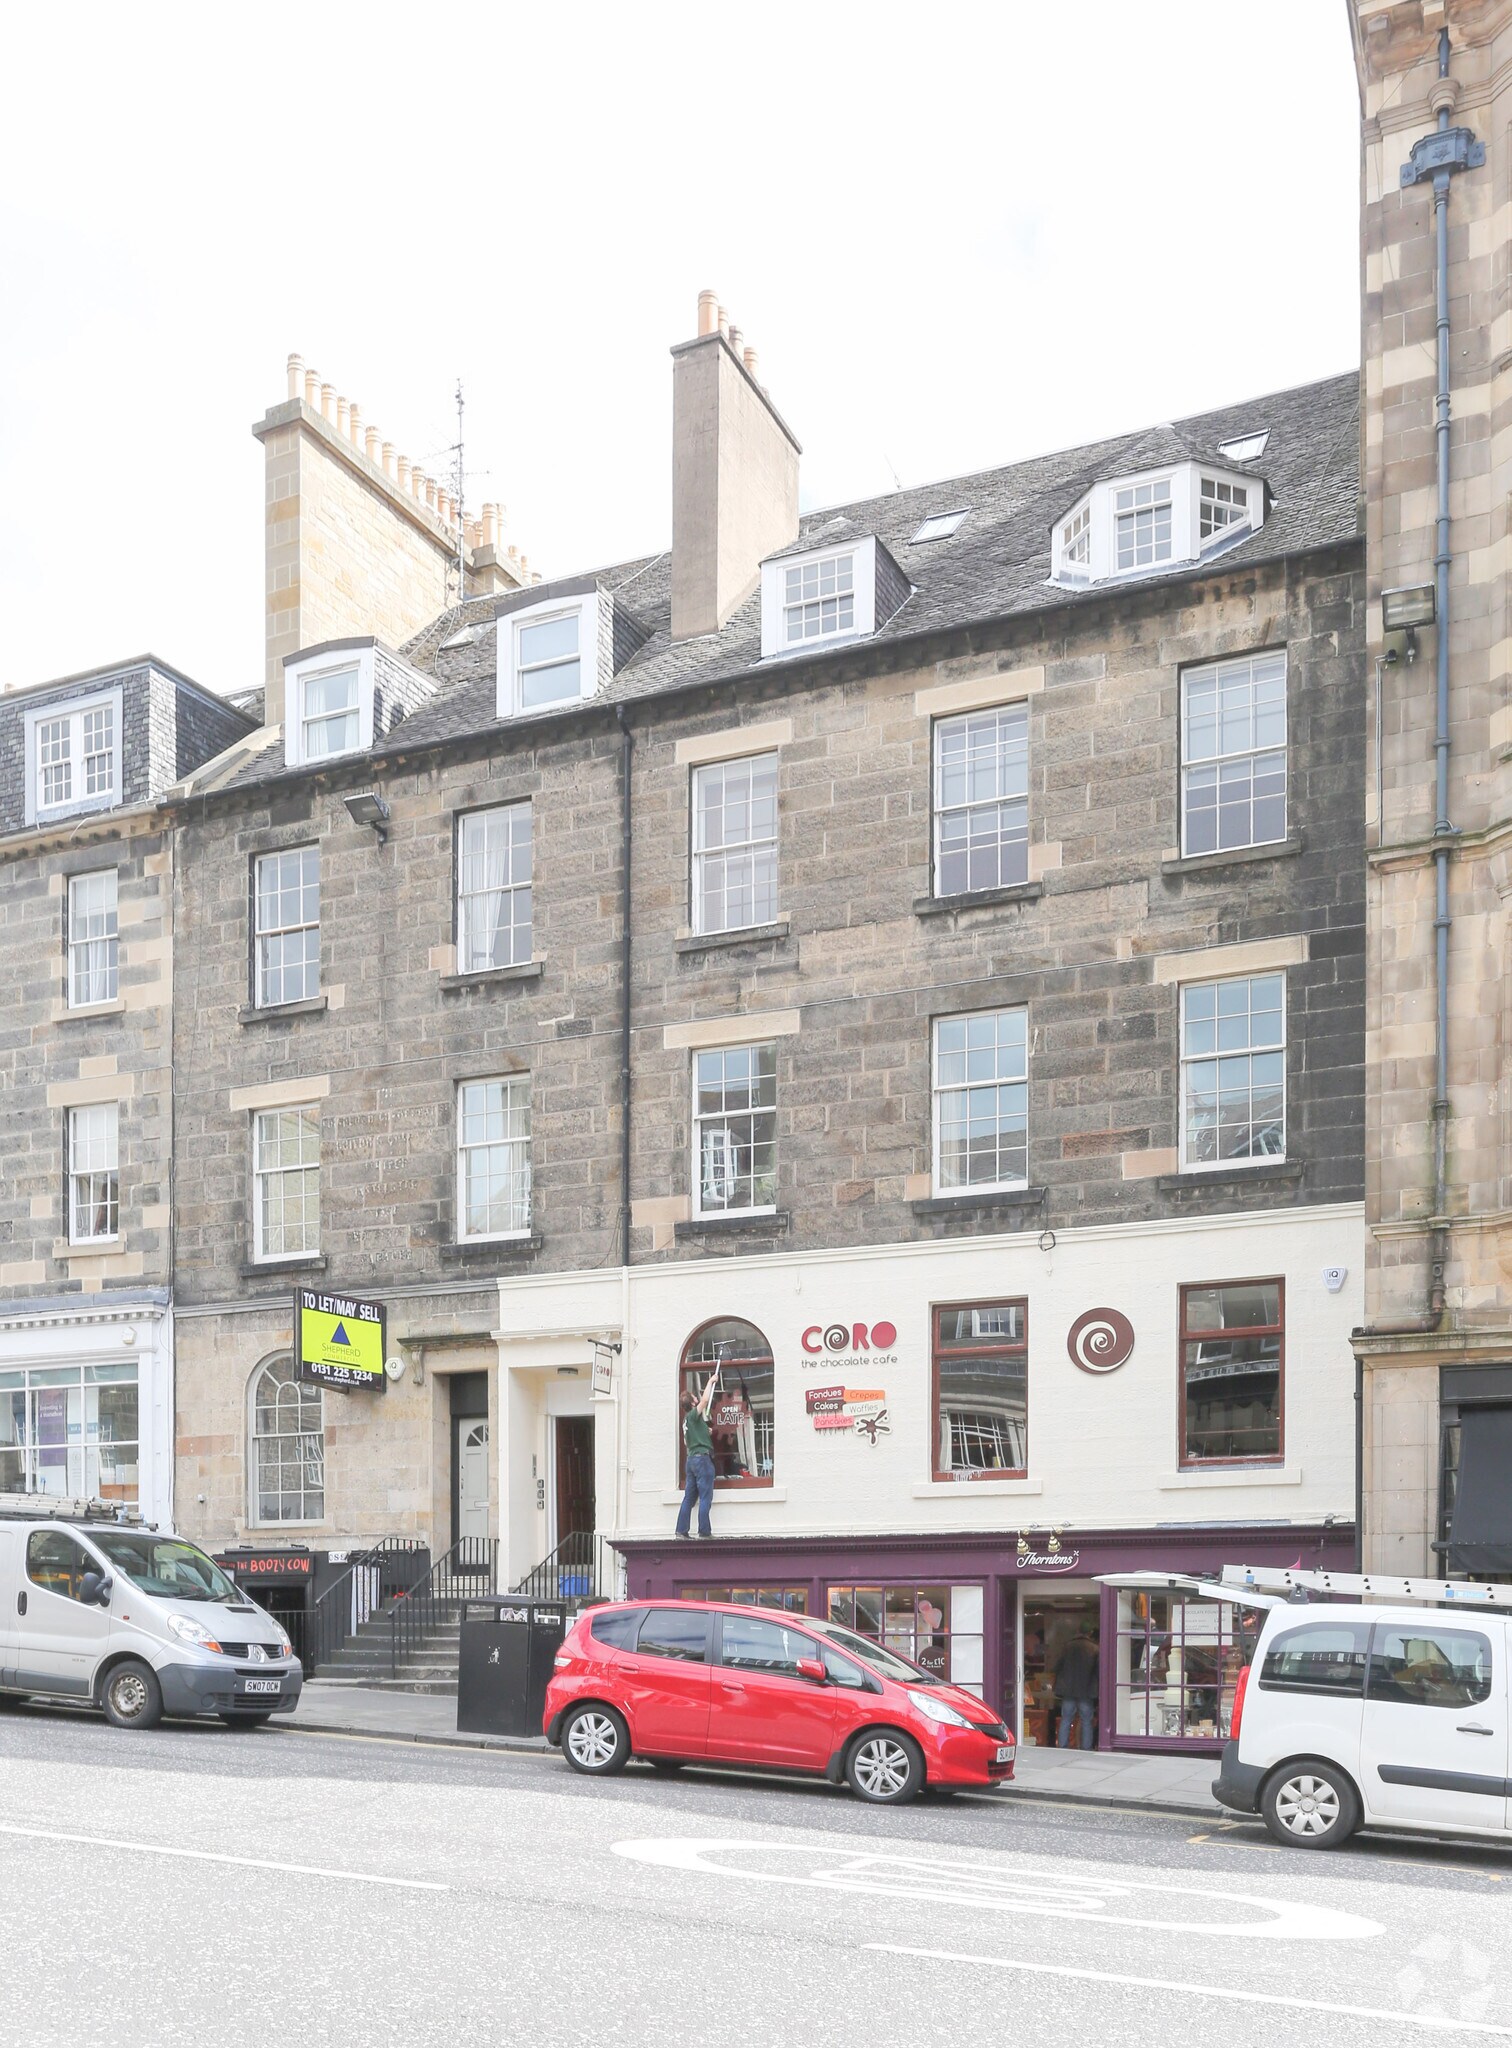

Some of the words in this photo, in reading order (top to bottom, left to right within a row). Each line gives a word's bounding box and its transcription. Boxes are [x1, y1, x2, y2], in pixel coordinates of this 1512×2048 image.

[303, 1292, 316, 1309] TO
[318, 1295, 357, 1317] LET/MAY
[359, 1304, 380, 1322] SELL
[801, 1321, 897, 1353] CORO
[321, 1343, 361, 1357] SHEPHERD
[801, 1359, 818, 1368] the
[820, 1355, 870, 1367] chocolate
[872, 1353, 898, 1364] cafe
[311, 1363, 331, 1375] 0131
[333, 1367, 350, 1378] 225
[352, 1370, 373, 1382] 1234
[808, 1389, 842, 1399] Fondues
[849, 1391, 880, 1400] Crepes
[813, 1402, 839, 1410] Cakes
[849, 1404, 879, 1413] Waffles
[716, 1412, 745, 1425] LATE
[250, 1559, 285, 1573] BOOZY
[286, 1558, 310, 1572] COW
[1017, 1552, 1073, 1568] Thorntons
[921, 1657, 927, 1666] 2
